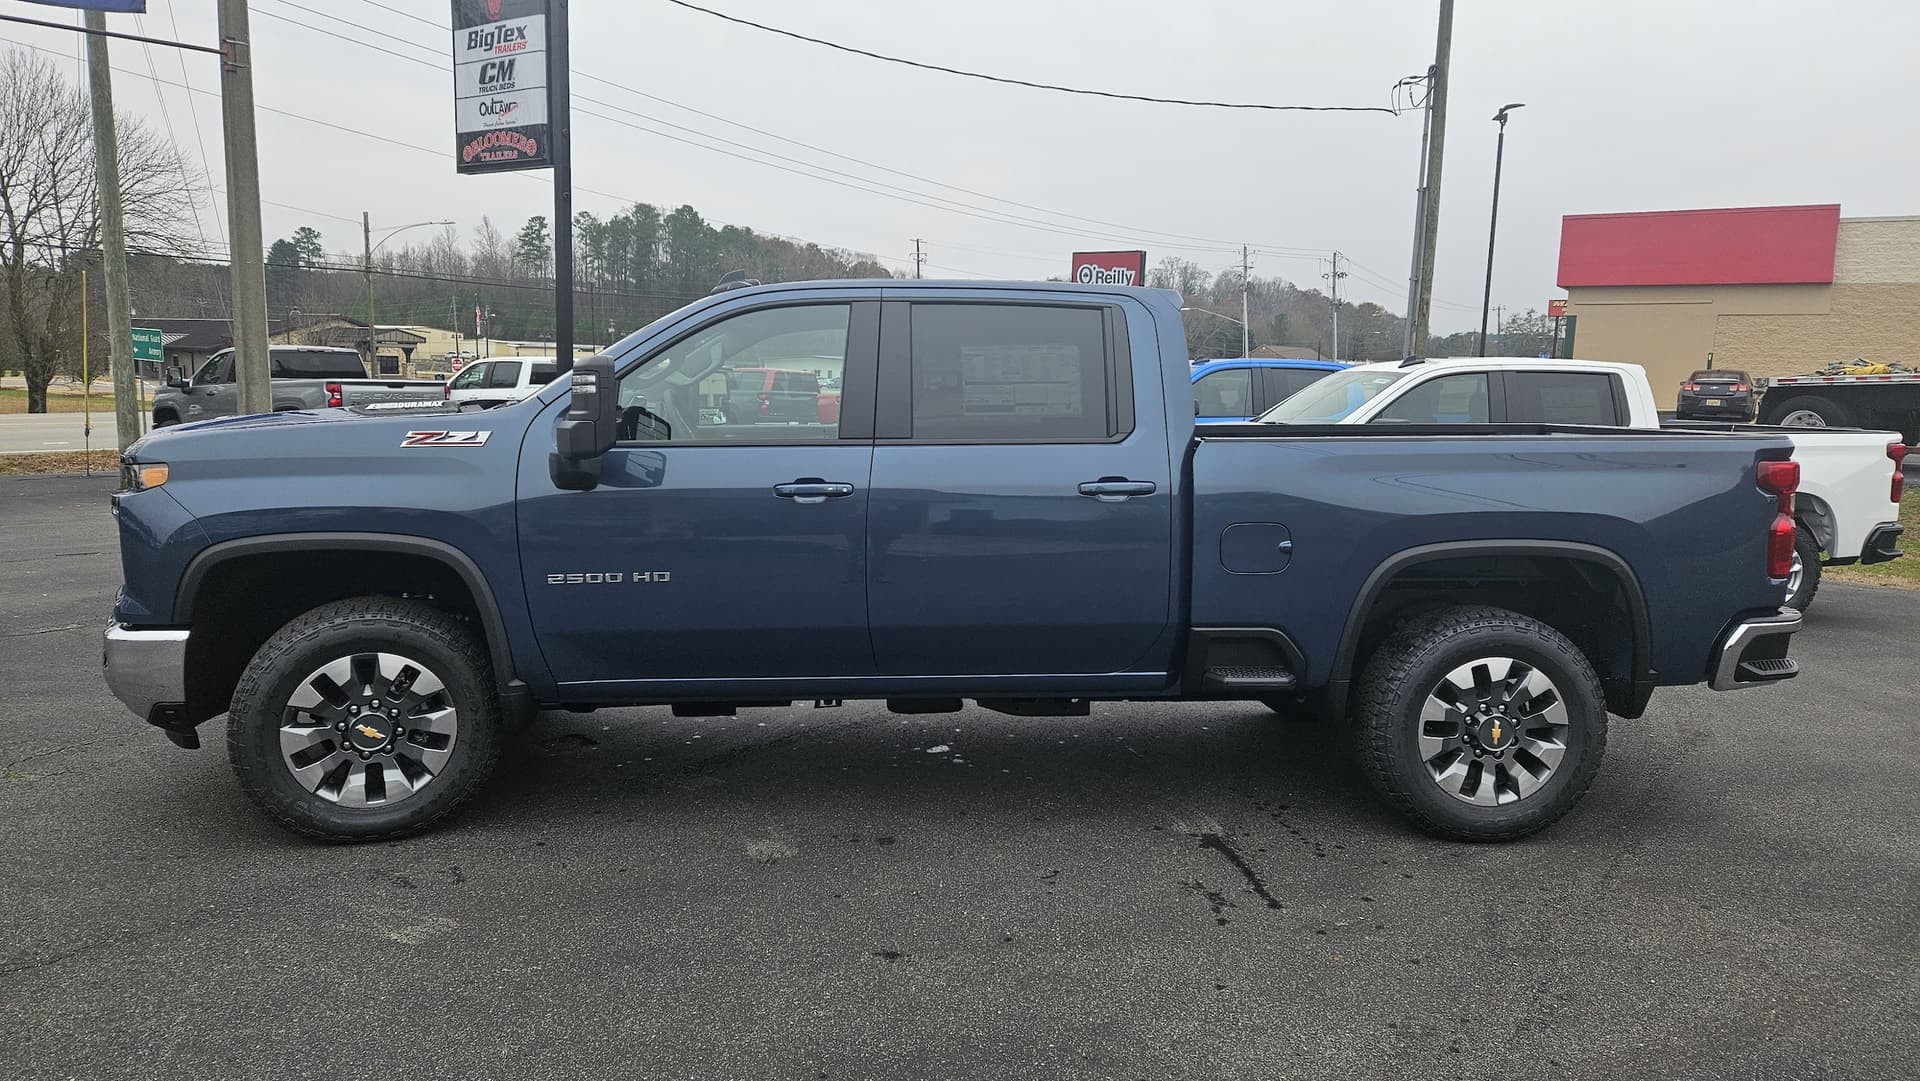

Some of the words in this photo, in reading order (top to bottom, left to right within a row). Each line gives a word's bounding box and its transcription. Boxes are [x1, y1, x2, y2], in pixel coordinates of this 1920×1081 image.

[494, 41, 528, 55] TRAILERS
[478, 58, 517, 85] CM
[479, 84, 498, 94] TRUCK
[499, 81, 516, 91] BEDS
[1078, 265, 1136, 286] O'Reilly
[396, 400, 444, 409] DURAMAX
[400, 431, 492, 448] Z71
[547, 572, 623, 585] 2500
[632, 571, 671, 583] HD
